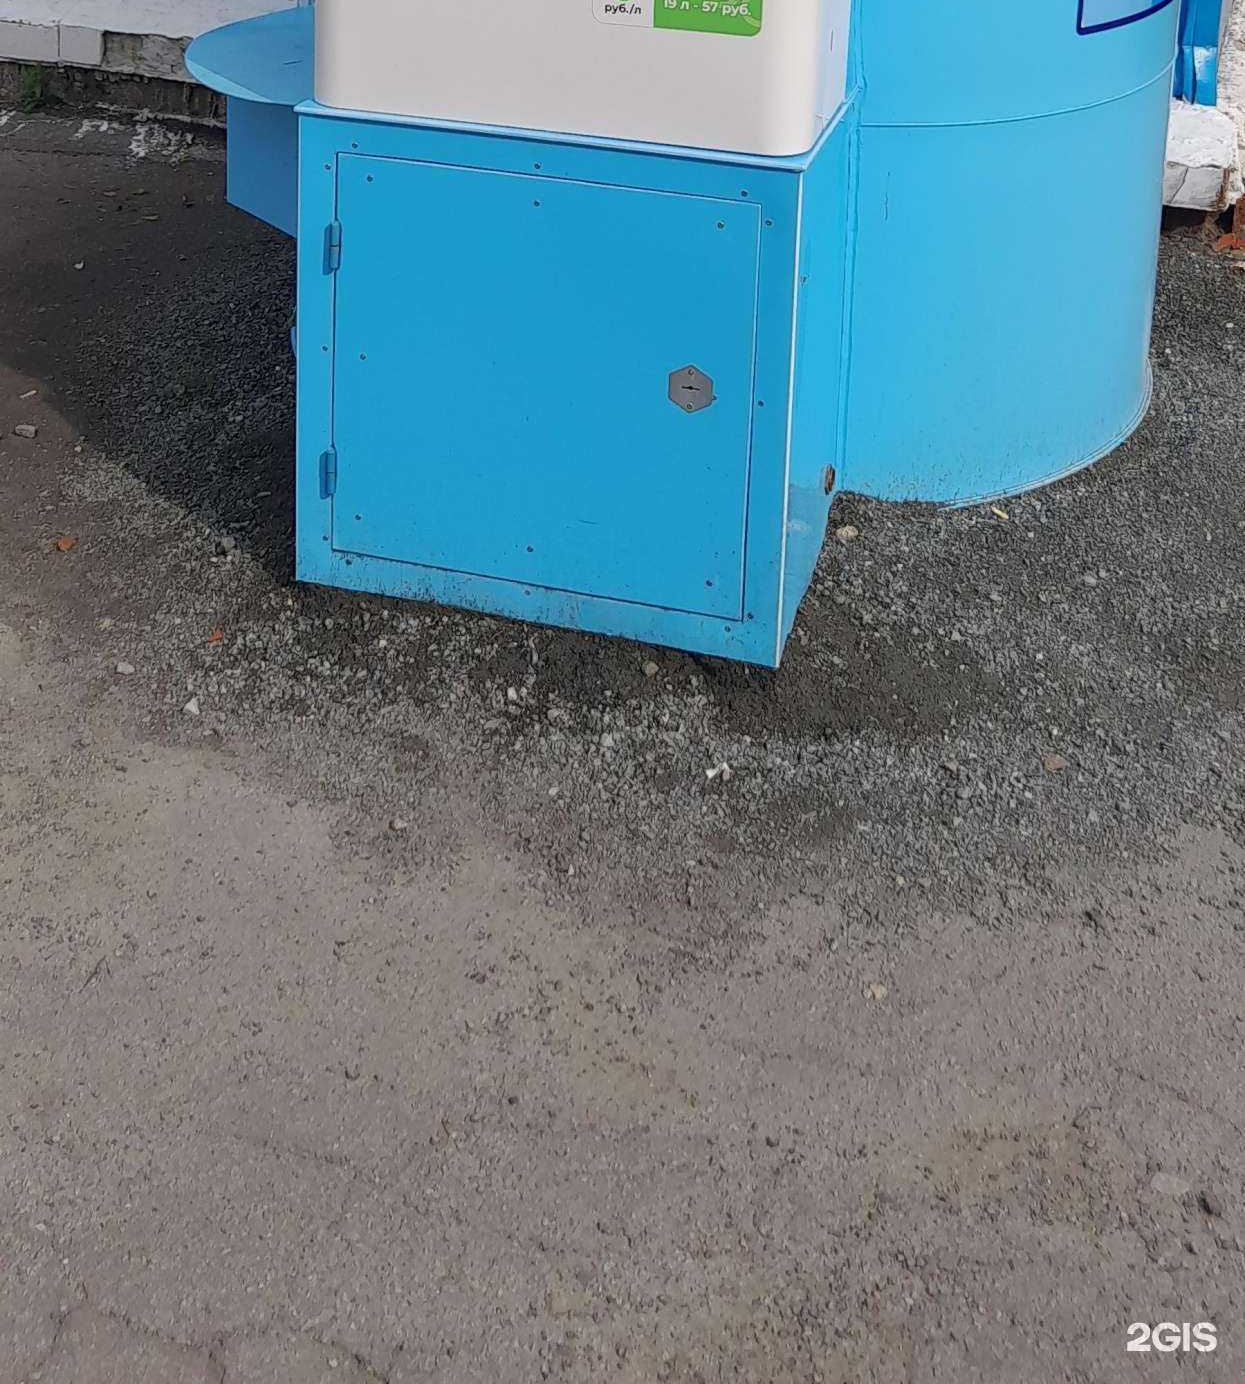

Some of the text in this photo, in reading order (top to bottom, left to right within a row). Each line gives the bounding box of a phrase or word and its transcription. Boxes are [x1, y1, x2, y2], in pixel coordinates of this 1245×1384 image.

[604, 3, 641, 15] руб./л
[680, 0, 689, 10] л
[702, 1, 718, 12] 57
[721, 3, 751, 17] руб.
